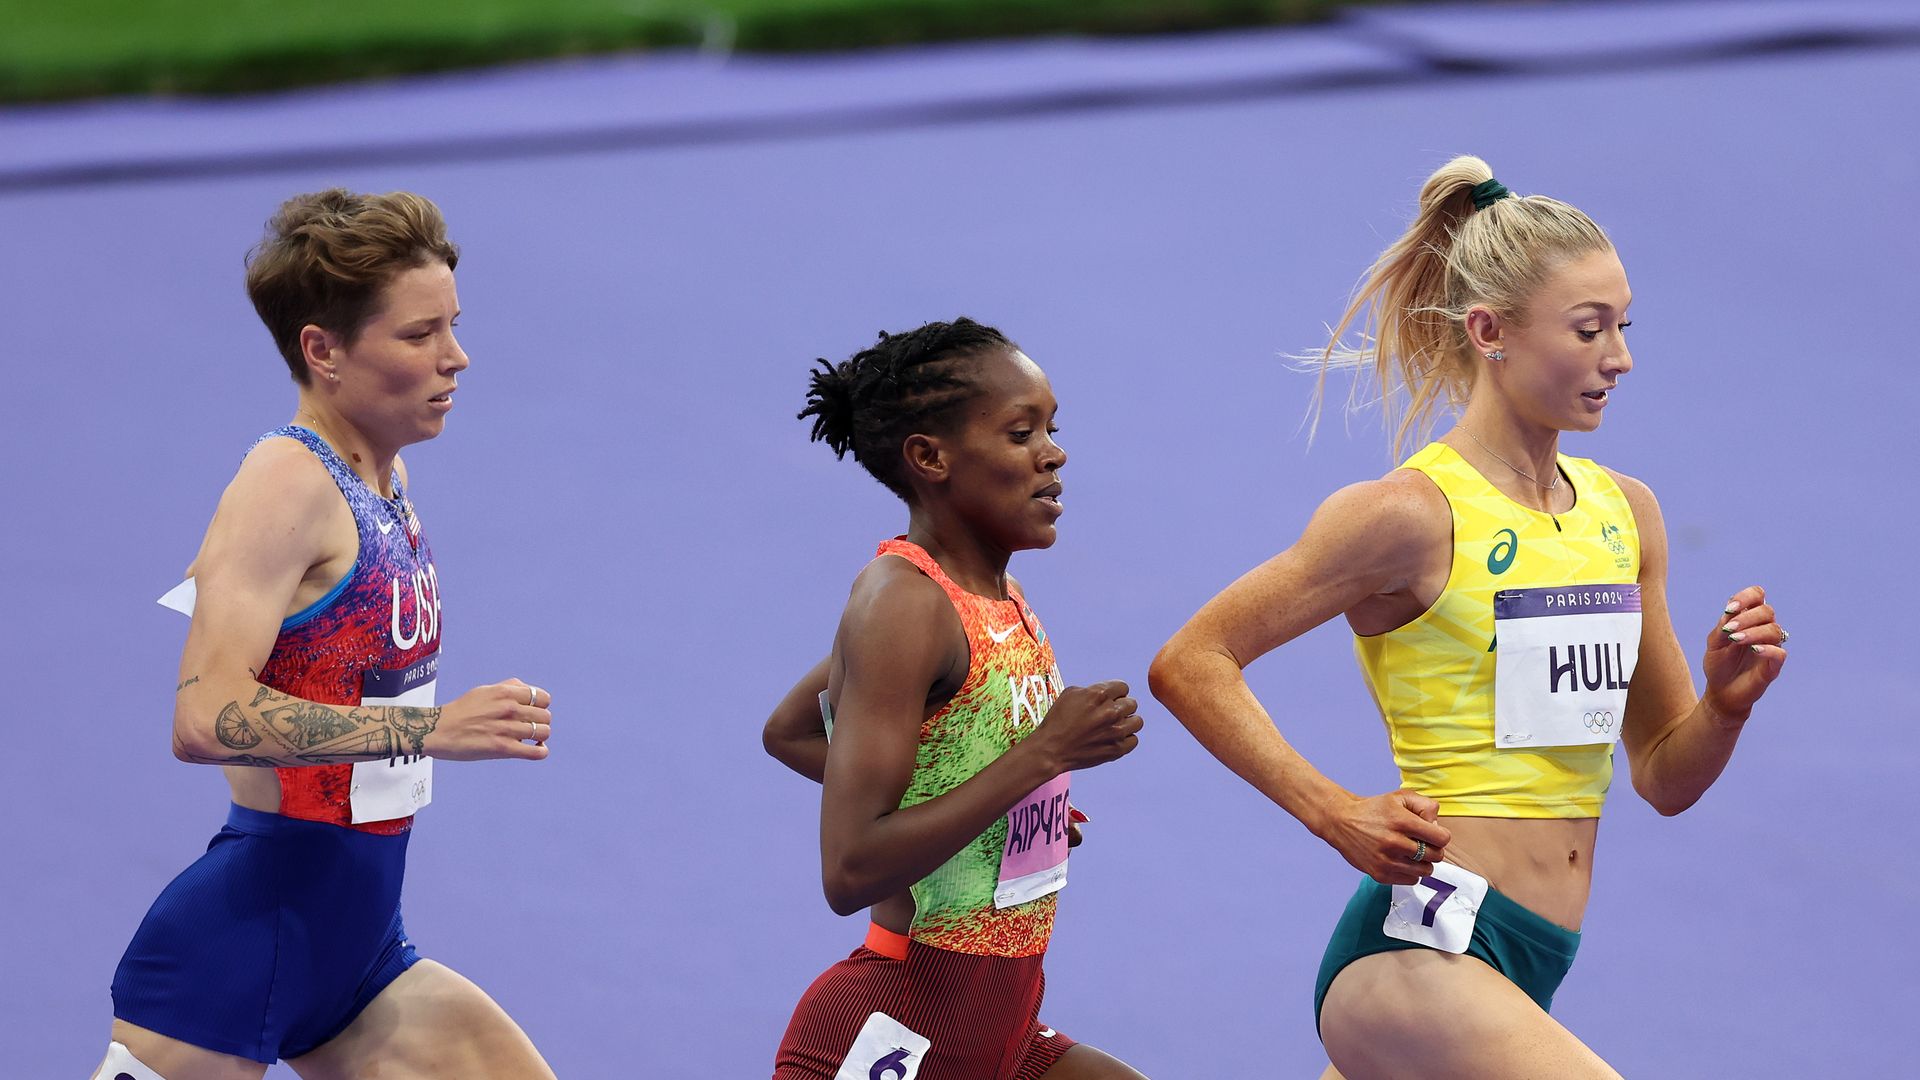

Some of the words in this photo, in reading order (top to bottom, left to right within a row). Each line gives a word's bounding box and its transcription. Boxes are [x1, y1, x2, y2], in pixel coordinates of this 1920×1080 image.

[1545, 593, 1591, 608] PARIS
[1595, 592, 1622, 605] 2024
[404, 665, 425, 685] PARIS
[1549, 642, 1629, 693] HULL
[1419, 876, 1458, 928] 7
[869, 1049, 908, 1080] 6
